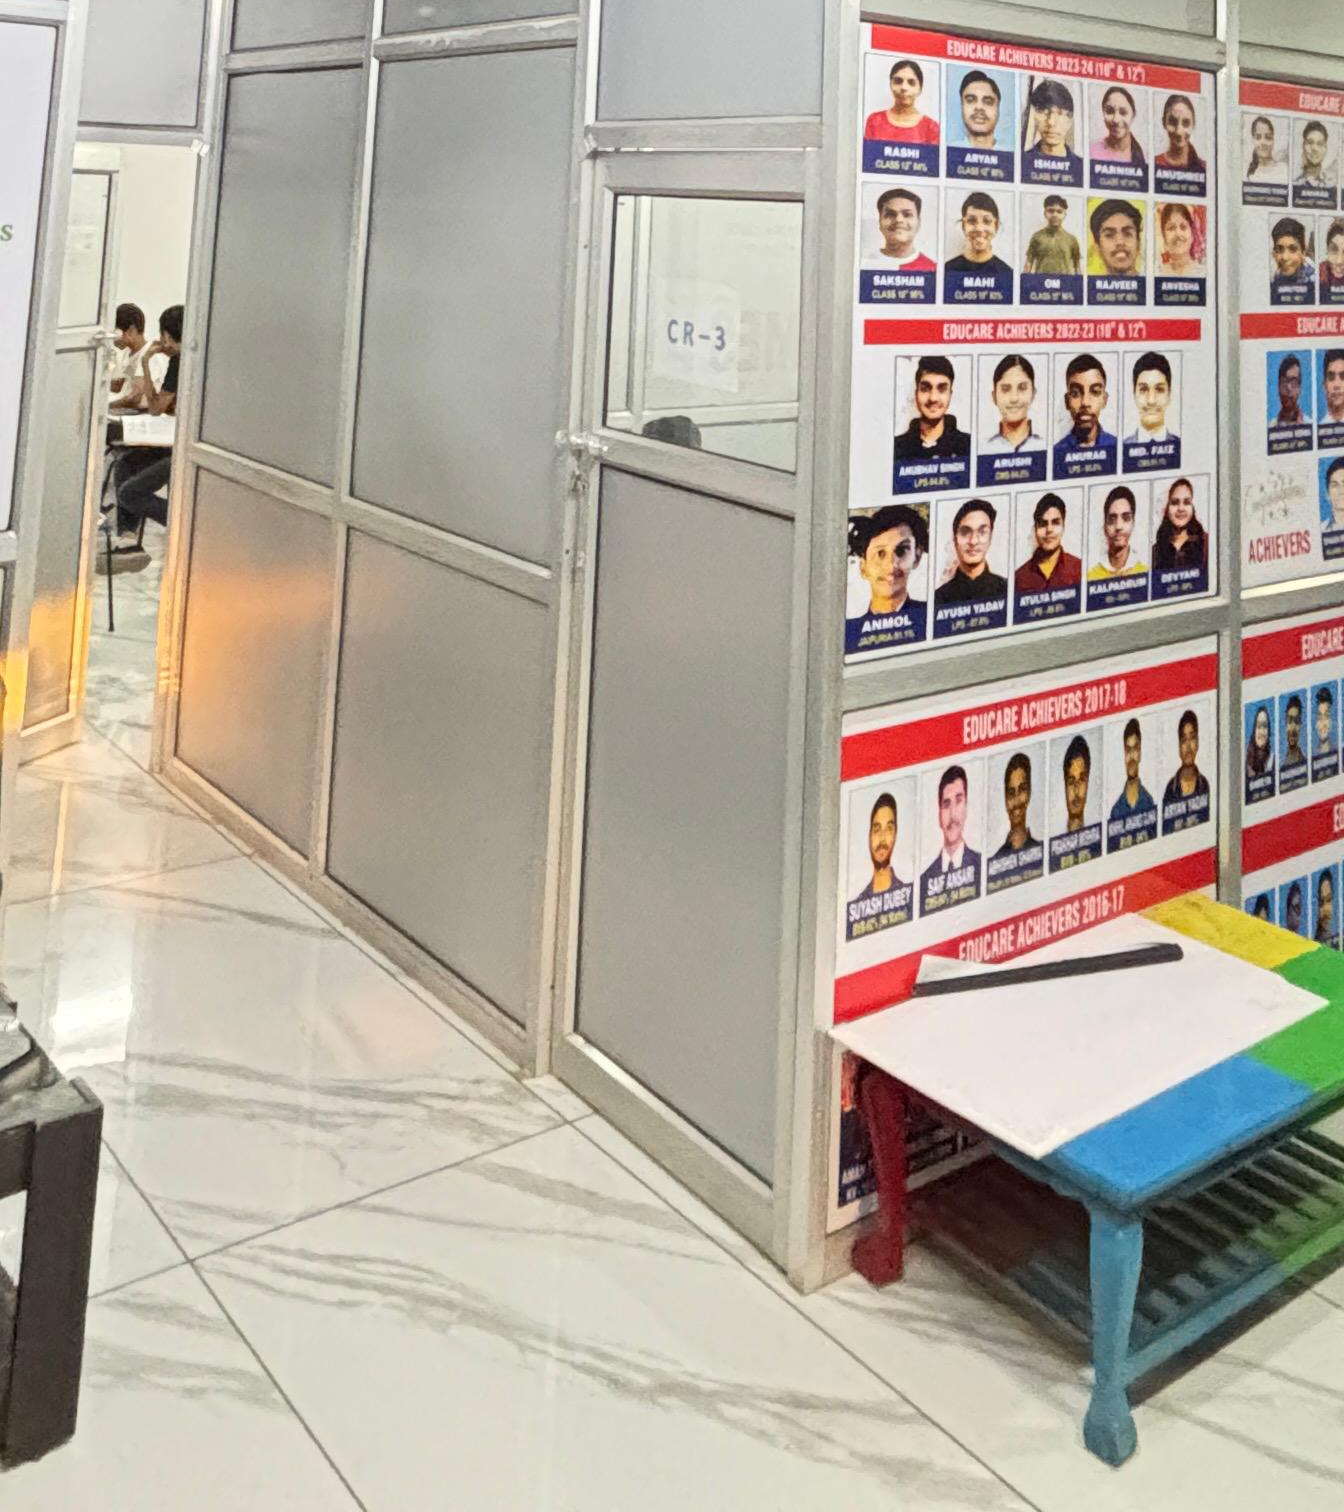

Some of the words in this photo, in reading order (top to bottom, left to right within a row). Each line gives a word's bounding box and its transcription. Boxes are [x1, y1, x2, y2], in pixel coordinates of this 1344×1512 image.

[946, 39, 996, 62] EDUCARE
[999, 45, 1055, 70] ACHIEVERS
[884, 146, 920, 159] RASHI
[964, 153, 998, 165] ARYAN
[873, 275, 925, 287] SAKSHAM
[964, 277, 996, 288] MAHI
[667, 319, 726, 351] CR-3
[943, 322, 995, 340] EDUCARE
[996, 322, 1055, 339] ACHIEVERS
[1056, 322, 1094, 339] 2022-23
[993, 457, 1033, 469] ARUSHI
[1248, 531, 1311, 564] ACHIEVERS
[936, 606, 971, 621] AYUSH
[973, 600, 1005, 615] YADAV
[862, 614, 912, 632] ANMOL
[963, 706, 1019, 745] EDUCARE
[1020, 691, 1083, 730] ACHIEVERS
[1085, 680, 1127, 715] 2017-18
[927, 874, 945, 896] SAIF
[849, 895, 883, 922] SUYASH
[883, 886, 912, 911] DUBEY
[958, 920, 1015, 962] EDUCARE
[1017, 902, 1081, 949] ACHIEVERS
[1082, 885, 1126, 923] 2016-17
